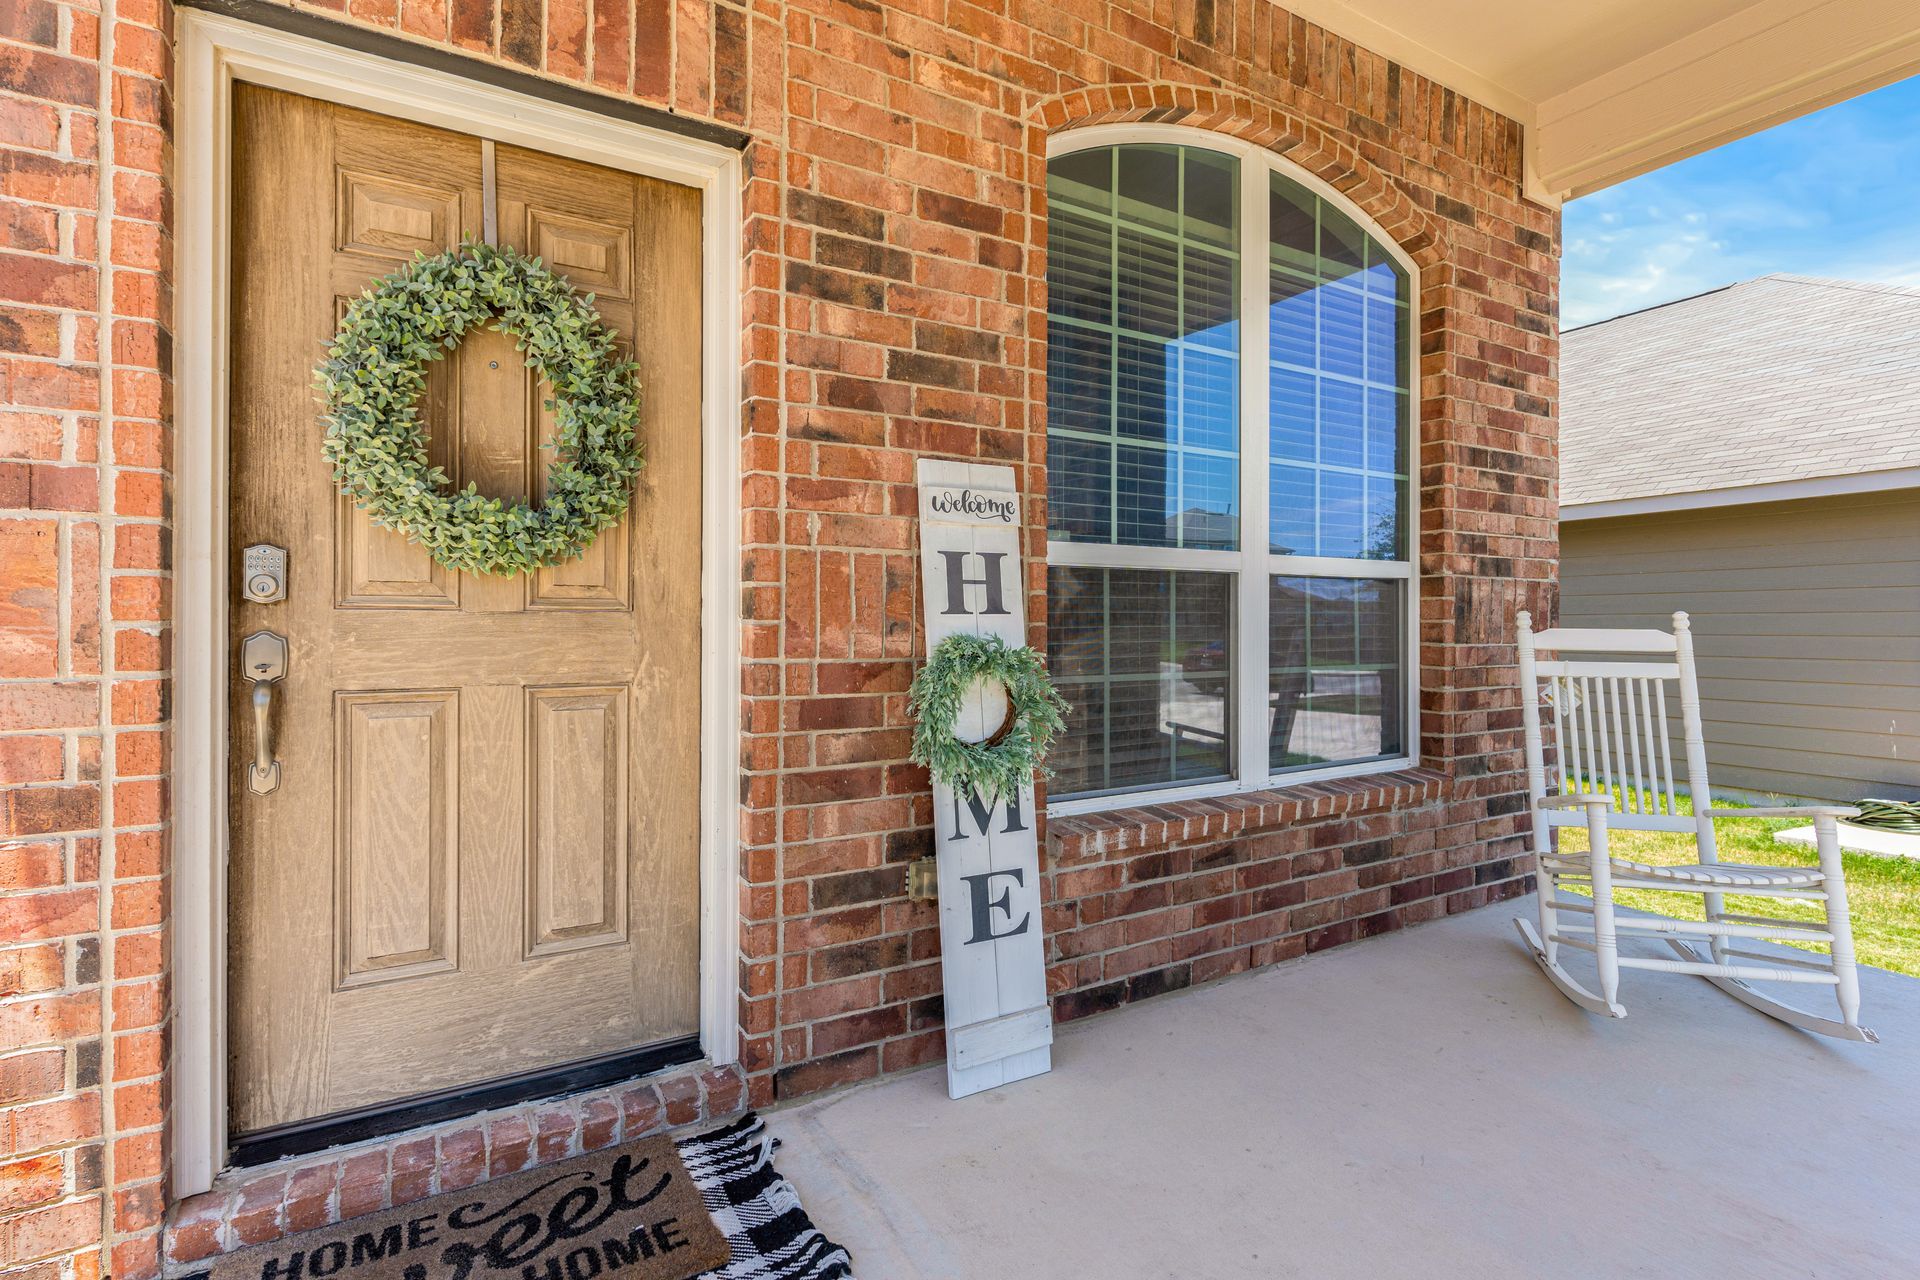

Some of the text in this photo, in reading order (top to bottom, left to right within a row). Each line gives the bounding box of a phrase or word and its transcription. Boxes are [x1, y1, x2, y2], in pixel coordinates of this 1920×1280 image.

[932, 490, 1015, 522] welcome
[937, 551, 1030, 945] HME
[262, 1213, 439, 1280] HOME
